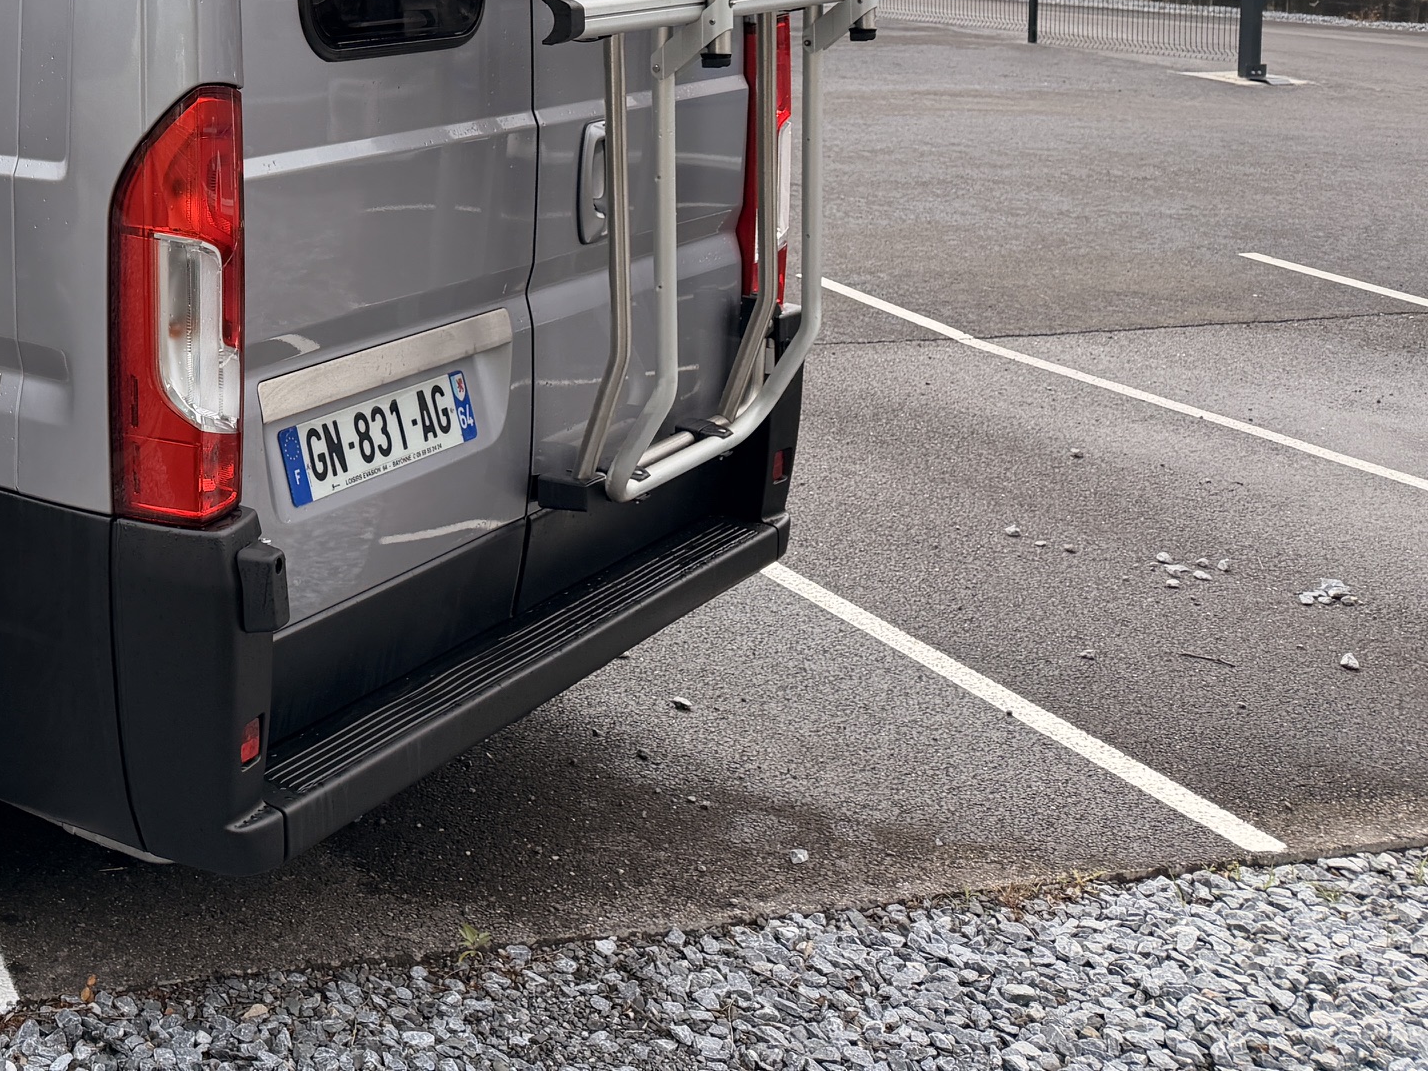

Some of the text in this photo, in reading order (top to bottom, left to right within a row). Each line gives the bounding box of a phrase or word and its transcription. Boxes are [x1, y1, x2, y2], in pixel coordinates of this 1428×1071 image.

[458, 406, 474, 429] 64
[306, 384, 452, 482] GN-831-AG
[392, 454, 412, 467] BAYONNE
[294, 469, 301, 485] F
